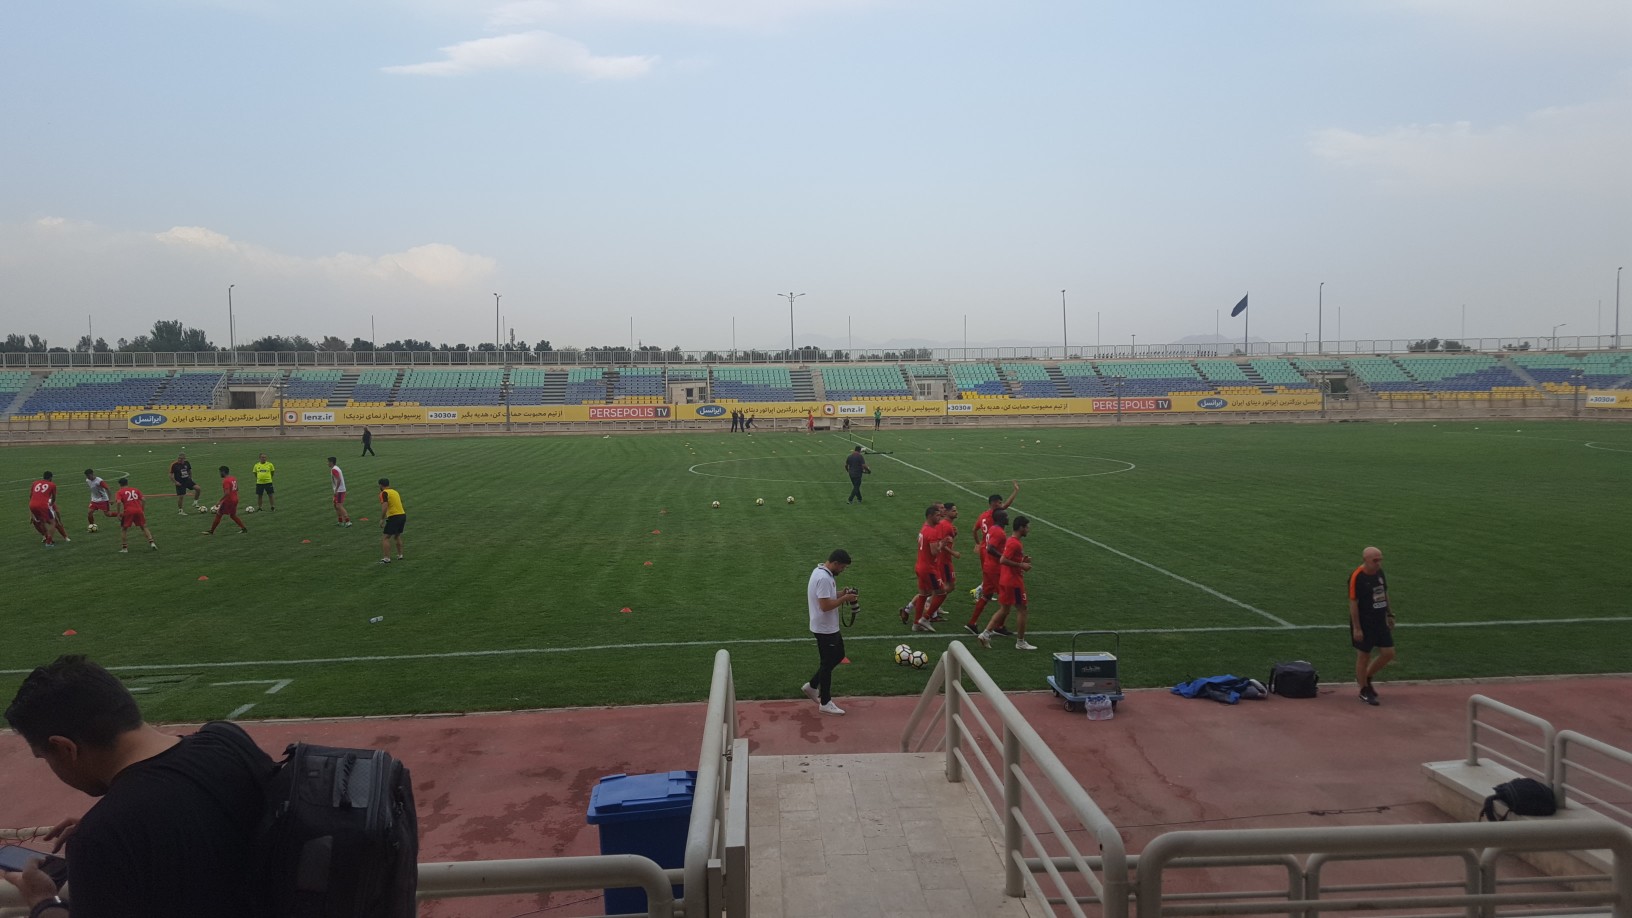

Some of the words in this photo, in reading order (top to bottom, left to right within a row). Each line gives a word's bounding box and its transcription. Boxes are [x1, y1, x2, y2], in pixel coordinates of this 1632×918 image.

[1092, 400, 1156, 410] PERSEPOLIS
[1157, 400, 1169, 409] TV
[1200, 399, 1223, 408] ایرانسل
[388, 412, 422, 420] پرسپولیس
[589, 407, 655, 418] PERSEPOLIS
[656, 407, 668, 417] TV
[699, 407, 722, 416] ایرانسل
[134, 415, 162, 425] ایرانسل
[171, 415, 188, 423] ایران
[207, 414, 227, 423] اپراتور
[228, 413, 254, 422] بزرگترین
[255, 413, 280, 421] ایرانسل
[304, 412, 333, 421] lenz.ir
[34, 482, 49, 493] 69
[124, 489, 139, 502] 26
[981, 518, 988, 534] 5
